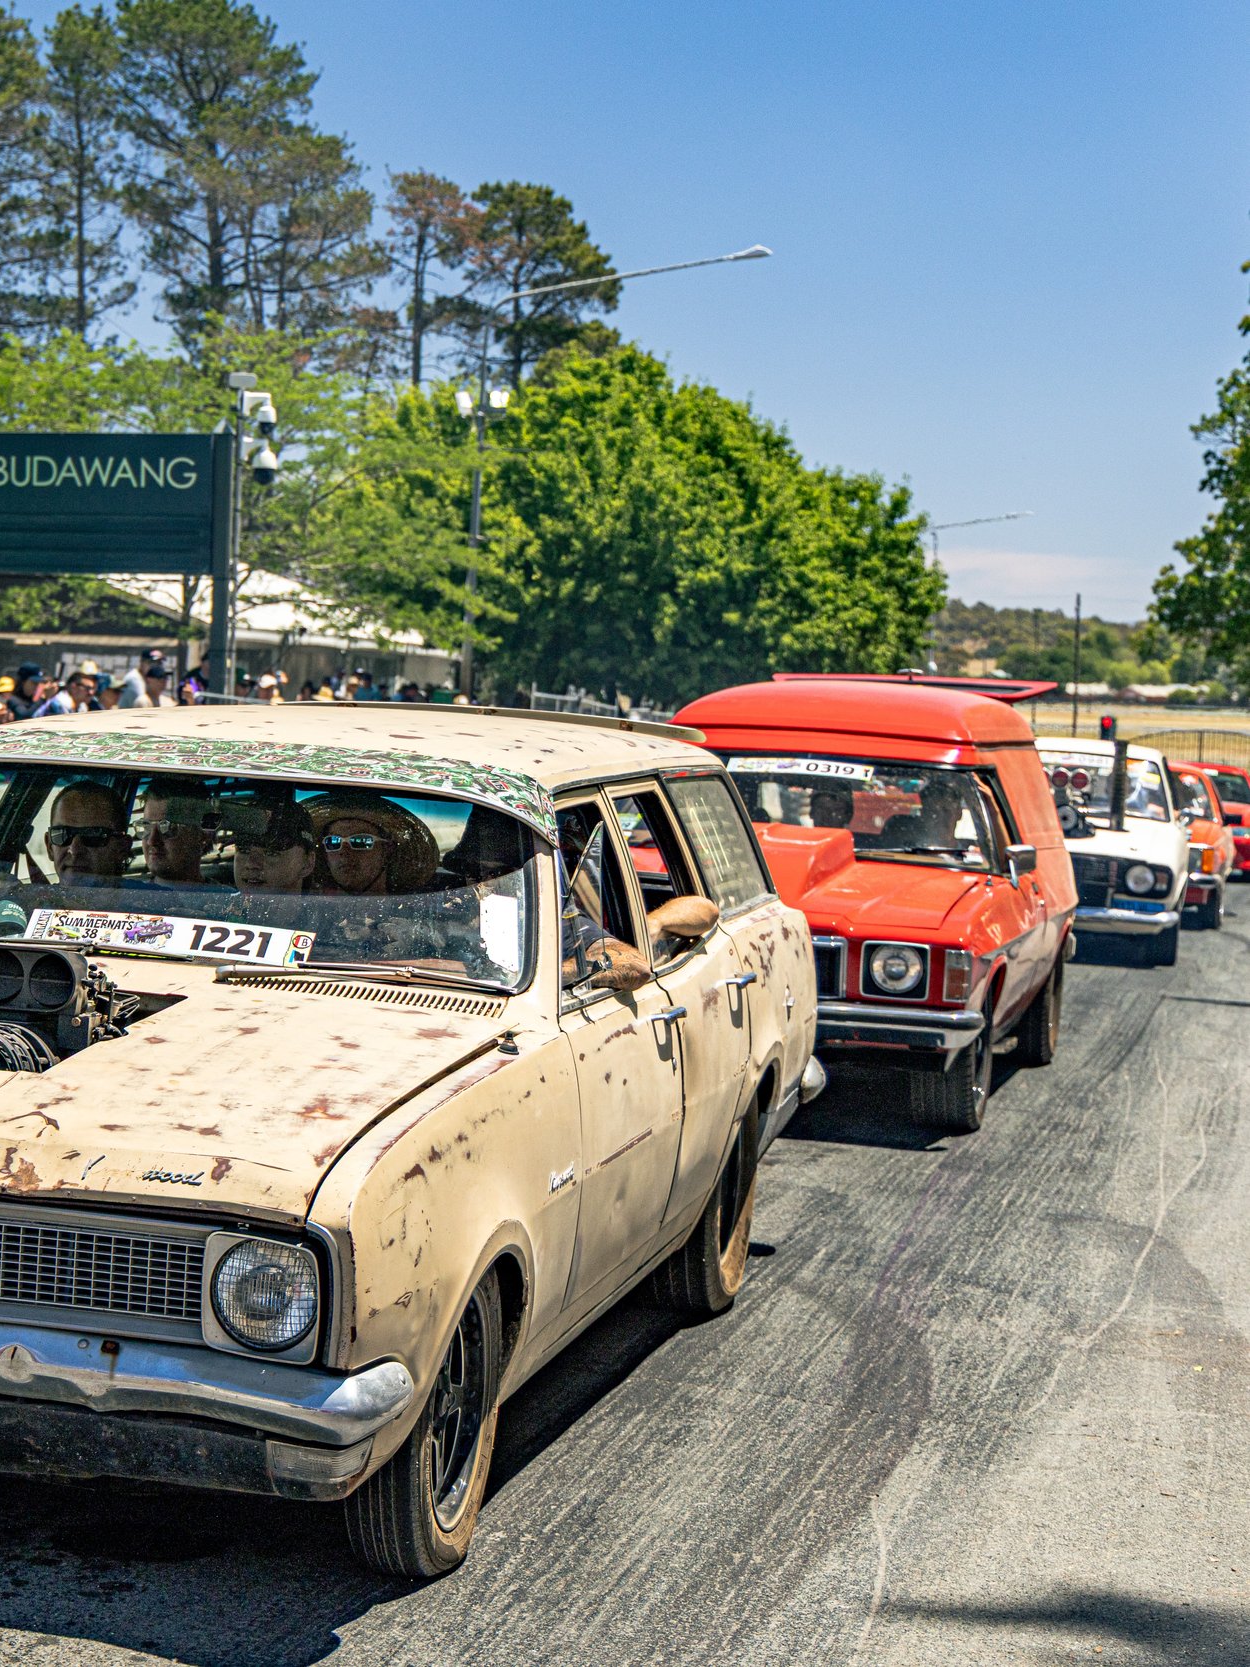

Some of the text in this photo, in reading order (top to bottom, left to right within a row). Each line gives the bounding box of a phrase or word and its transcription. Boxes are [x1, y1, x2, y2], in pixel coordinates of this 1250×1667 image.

[805, 762, 855, 775] 0319
[58, 914, 134, 931] SUMMERNATS
[82, 928, 98, 939] 38
[190, 924, 272, 958] 1221
